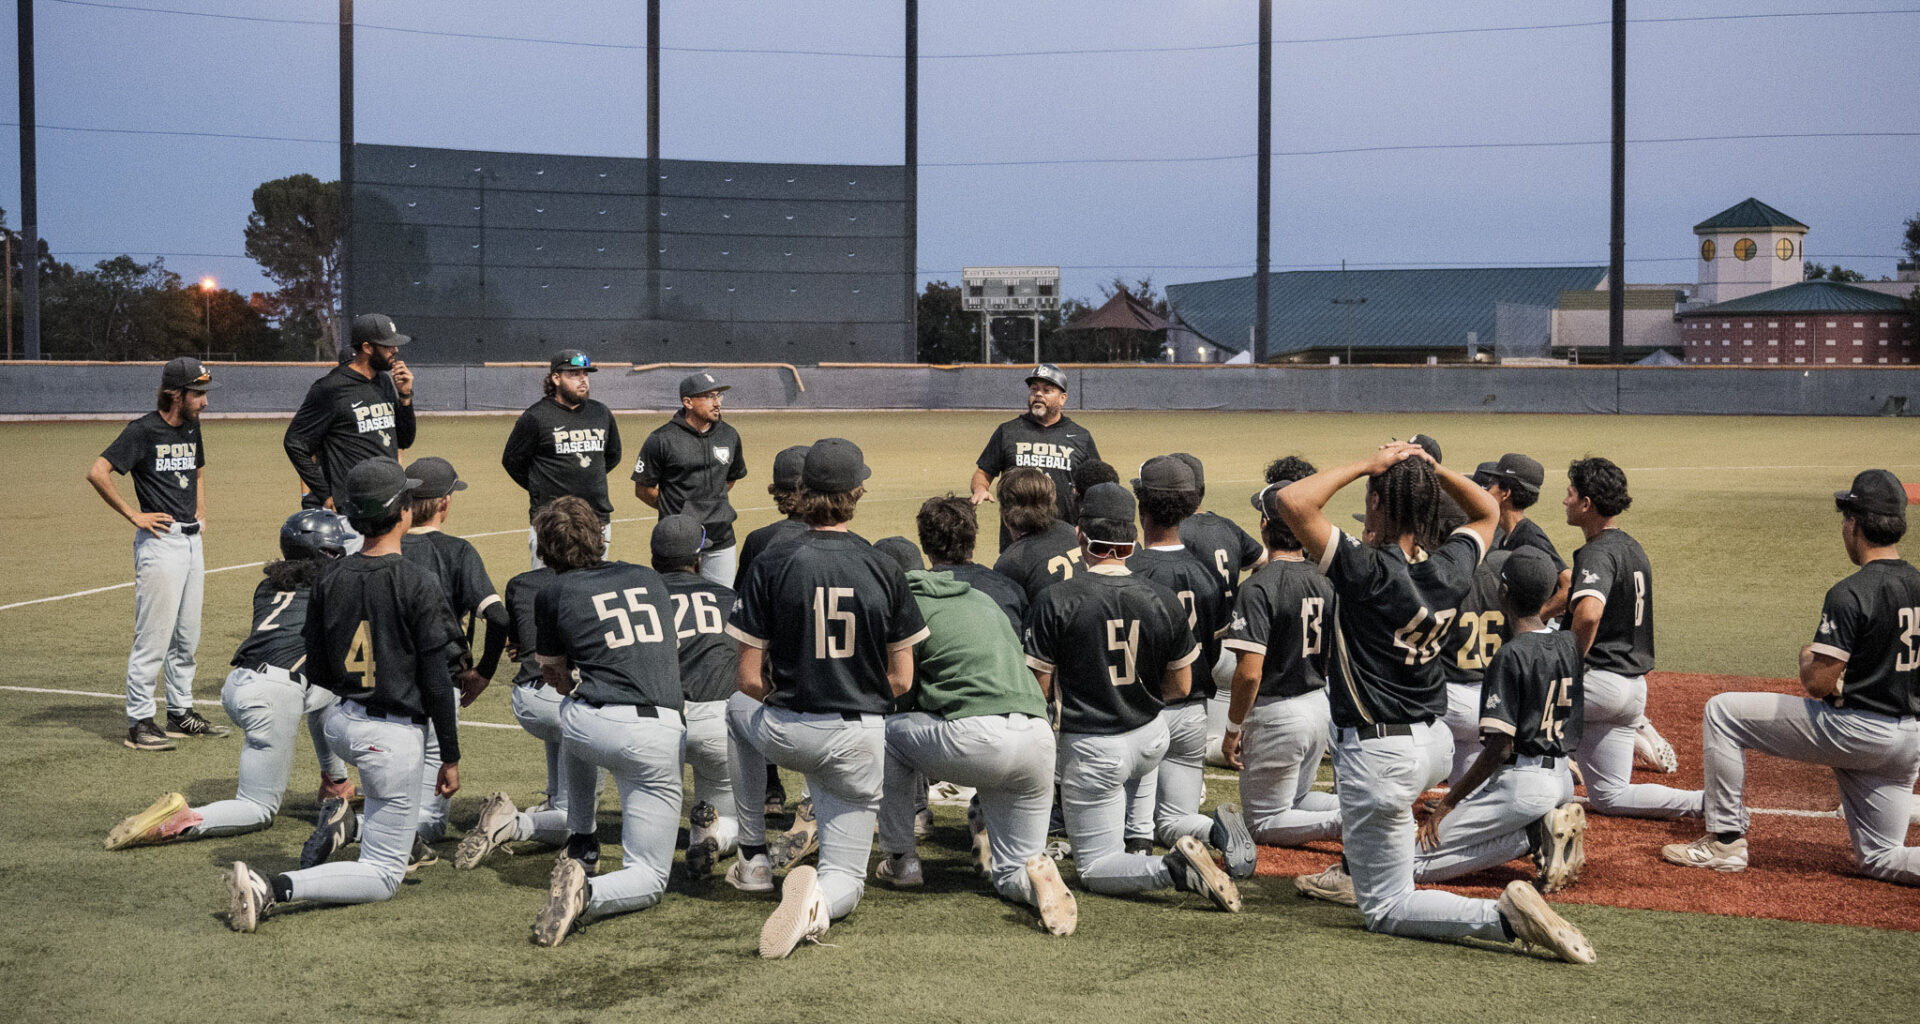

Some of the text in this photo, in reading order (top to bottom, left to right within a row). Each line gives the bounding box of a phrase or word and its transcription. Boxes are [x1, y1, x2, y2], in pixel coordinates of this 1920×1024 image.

[155, 443, 197, 458] POLY
[552, 429, 605, 443] POLY
[1016, 442, 1074, 458] POLY
[1016, 454, 1072, 471] BASEBALL
[257, 591, 297, 631] 2
[591, 587, 664, 650] 55
[670, 591, 723, 640] 26
[813, 586, 856, 659] 15
[1300, 597, 1325, 658] 13
[344, 620, 376, 688] 4
[1457, 610, 1505, 669] 26
